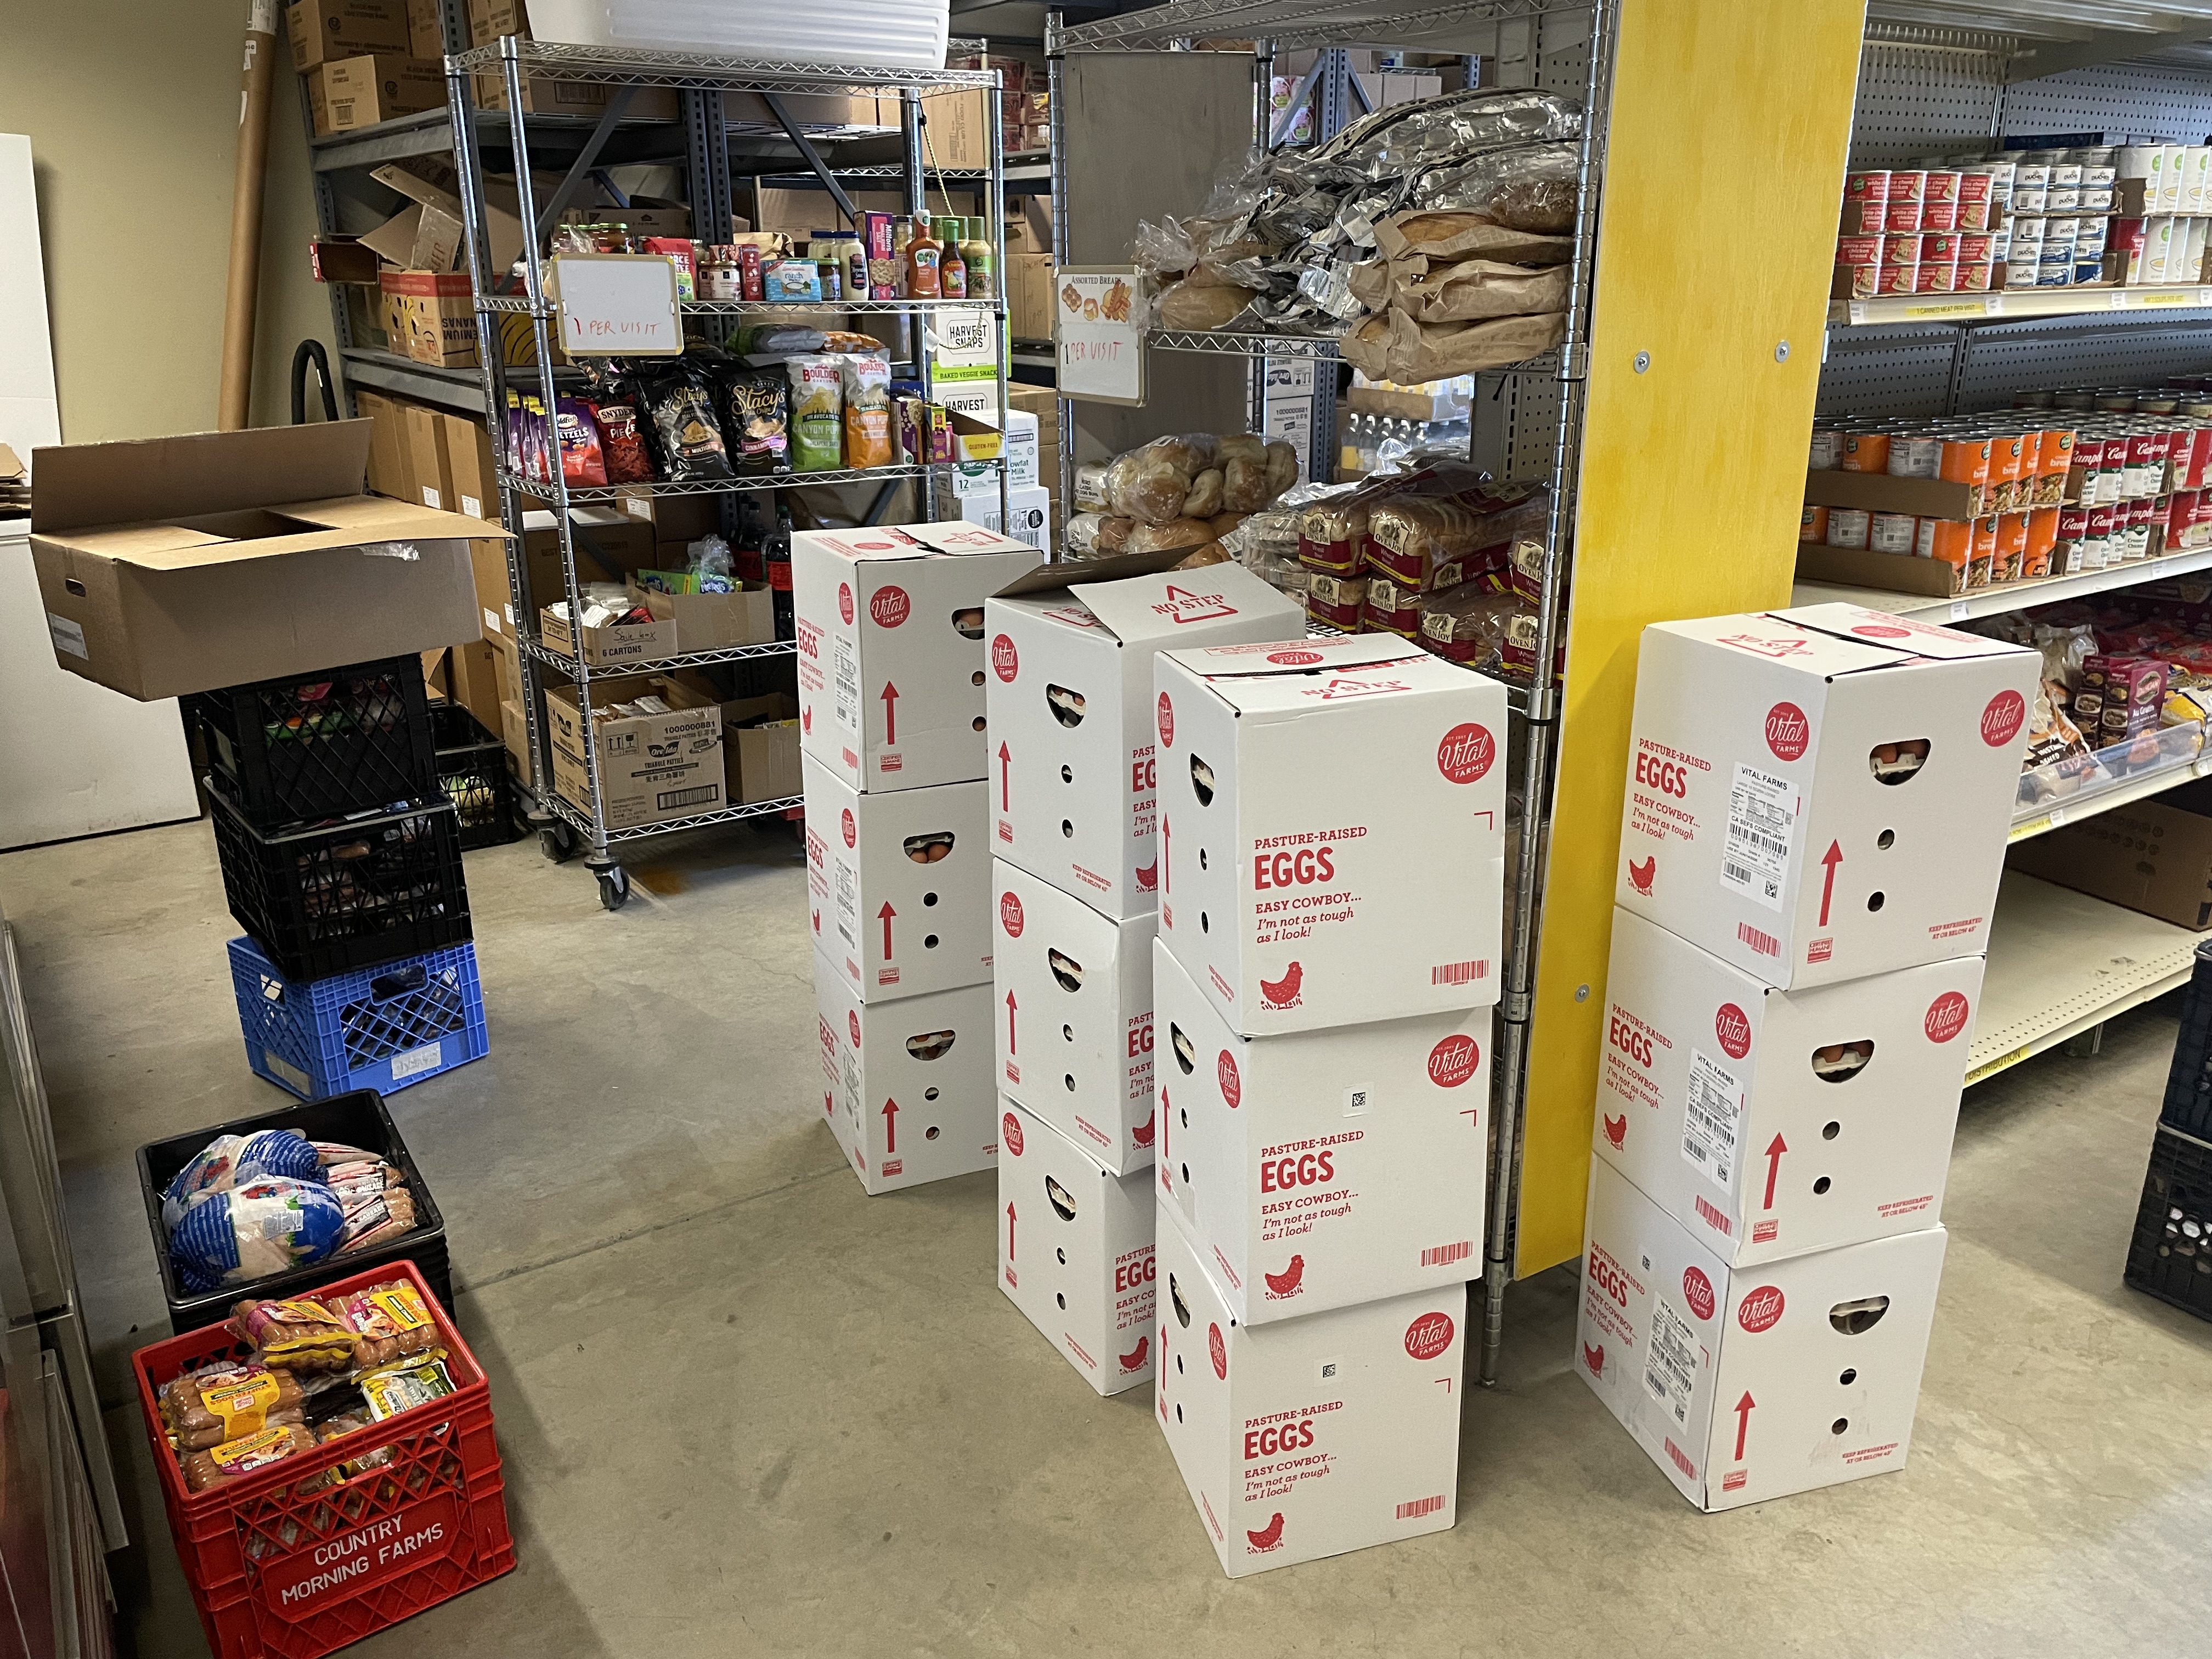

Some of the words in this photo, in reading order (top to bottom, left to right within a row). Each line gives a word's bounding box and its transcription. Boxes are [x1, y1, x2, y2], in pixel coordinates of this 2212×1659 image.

[884, 224, 893, 252] Milton's
[1071, 276, 1098, 285] ASSORTED
[442, 318, 477, 328] NANAS
[589, 320, 614, 336] PER
[621, 321, 661, 336] VISIT
[949, 325, 988, 338] HARVEST
[444, 330, 478, 340] EMIUM
[955, 336, 984, 348] SNAPS
[1071, 342, 1086, 361] PER
[1091, 341, 1124, 361] VISIT
[803, 369, 840, 383] BOULDER
[858, 363, 887, 376] BOULDER
[959, 370, 979, 379] VEGGIE
[672, 386, 708, 411] Stacy's
[732, 385, 786, 415] Stacy's
[946, 399, 985, 410] HARVEST
[557, 415, 577, 425] oldfish
[792, 424, 823, 435] CANYON
[560, 427, 589, 439] ETZELS
[1009, 459, 1029, 468] owfat
[958, 479, 969, 489] 12
[871, 594, 905, 618] Vital
[1151, 602, 1180, 616] NO
[1178, 594, 1224, 610] STEP
[882, 613, 904, 625] FARMS
[608, 645, 642, 657] CARTONS
[798, 625, 818, 660] EGGS
[992, 648, 1015, 668] Vital
[1301, 686, 1335, 697] NO
[1342, 679, 1403, 693] STEP
[1982, 697, 2024, 735] Vital
[664, 720, 716, 735] 1000000881
[1766, 711, 1804, 744] Vital
[1990, 725, 2015, 742] FARMS
[1440, 731, 1488, 770] Vital
[1639, 737, 1712, 772] PASTURE-RAISED
[1776, 743, 1800, 754] FARMS
[644, 759, 665, 769] TRIANGLE
[666, 757, 684, 766] PATTIES
[1454, 761, 1485, 778] FARMS
[1635, 752, 1688, 799] EGGS
[1741, 766, 1762, 782] VITAL
[1763, 774, 1788, 791] FARMS
[1633, 793, 1655, 811] EASY
[1656, 802, 1701, 829] COWBOY...
[1630, 820, 1641, 830] as
[1641, 822, 1646, 833] I
[1646, 825, 1666, 842] look!
[1633, 806, 1645, 820] I'm
[1646, 812, 1660, 826] not
[1660, 820, 1670, 830] as
[1671, 821, 1695, 842] tough
[1731, 815, 1740, 824] CA
[1739, 819, 1754, 831] SEFS
[1753, 824, 1786, 843] COMPLIANT
[1255, 826, 1368, 850] PASTURE-RAISED
[807, 835, 824, 869] EGGS
[1255, 847, 1335, 890] EGGS
[1001, 902, 1022, 924] Vital
[1255, 900, 1289, 914] EASY
[1293, 892, 1362, 910] COWBOY...
[1256, 918, 1277, 930] I'm
[1279, 915, 1301, 927] not
[1302, 914, 1317, 924] as
[1319, 907, 1355, 923] tough
[1928, 924, 1942, 934] KEEP
[1943, 917, 1983, 930] REFRIGERATED
[1256, 933, 1271, 944] as
[1273, 930, 1280, 941] I
[1282, 926, 1312, 940] look!
[1947, 927, 1968, 938] BELOW
[1612, 1003, 1672, 1049] PASTURE-RAISED
[1717, 1012, 1747, 1045] Vital
[1610, 1015, 1652, 1069] EGGS
[1724, 1041, 1745, 1054] FARMS
[1429, 1042, 1474, 1077] Vital
[1697, 1053, 1713, 1072] VITAL
[1714, 1064, 1734, 1086] FARMS
[1968, 1049, 2021, 1081] DISTRIBUTION
[1442, 1066, 1471, 1084] FARMS
[1261, 1131, 1364, 1158] PASTURE-RAISED
[1261, 1149, 1335, 1194] EGGS
[1262, 1199, 1293, 1216] EASY
[1295, 1189, 1359, 1209] COWBOY...
[1588, 1251, 1628, 1308] EGGS
[1739, 1293, 1780, 1324] Vital
[1750, 1314, 1775, 1330] FARMS
[1406, 1317, 1448, 1352] Vital
[1418, 1341, 1445, 1357] FARMS
[1245, 1400, 1344, 1429] PASTURE-RAISED
[1244, 1419, 1314, 1460] EGGS
[1244, 1464, 1274, 1480] EASY
[1277, 1453, 1337, 1472] COWBOY...
[314, 1514, 403, 1566] COUNTRY
[281, 1556, 370, 1605] MORNING
[379, 1522, 444, 1565] FARMS
